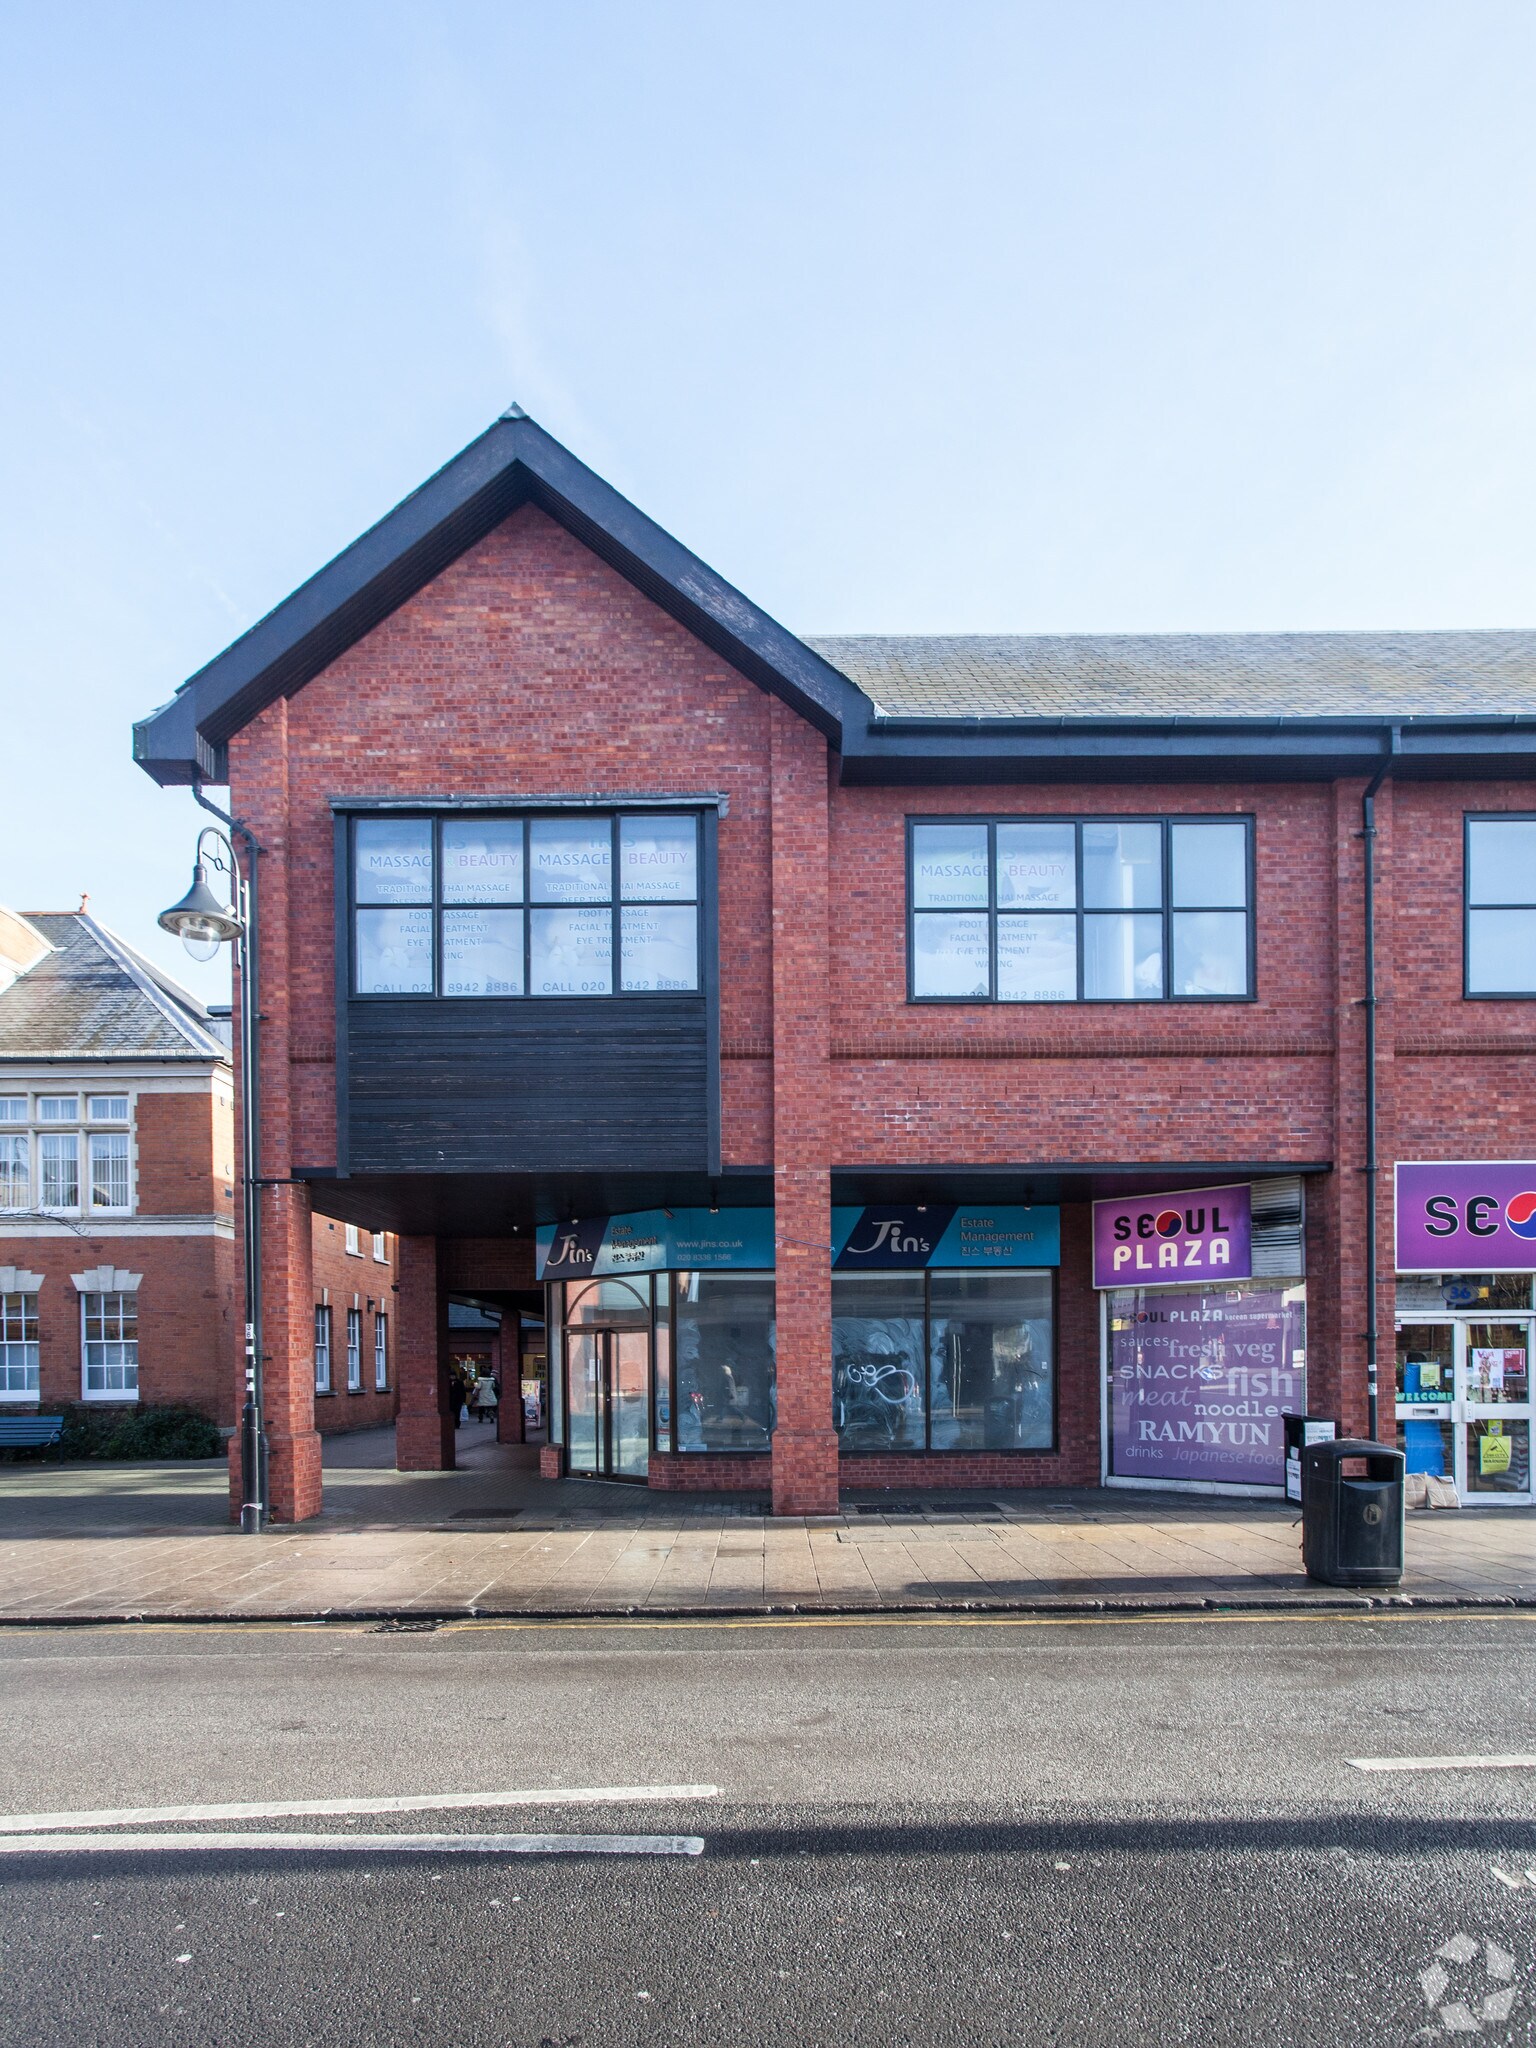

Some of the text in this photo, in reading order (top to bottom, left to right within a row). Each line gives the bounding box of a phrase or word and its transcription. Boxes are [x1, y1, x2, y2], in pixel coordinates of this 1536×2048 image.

[370, 856, 432, 868] MASSAG
[459, 854, 518, 866] BEAUTY
[538, 852, 688, 866] MASSAGE BEAUTY
[921, 865, 989, 876] MASSAGE
[1009, 865, 1066, 876] BEAUTY
[377, 885, 432, 893] TRADITIONA
[467, 884, 510, 892] MASSAGE
[546, 883, 608, 892] TRADITIONAL
[636, 882, 680, 890] MASSAGE
[928, 894, 988, 902] TRADITIONAL
[408, 912, 479, 920] FOOT ASSAGE
[578, 909, 648, 918] FOOT MSSAGE
[400, 924, 488, 934] FACIAL EATMENT
[604, 923, 659, 931] TATMENT
[958, 920, 1028, 928] FOOT SSAGE
[408, 938, 482, 946] EYE TATMENT
[576, 936, 652, 944] EYE TRETMENT
[950, 934, 1038, 942] FACIAL TEATMENT
[595, 950, 634, 958] WANG
[976, 946, 1031, 954] TRTMENT
[974, 960, 1013, 968] WANG
[448, 983, 480, 992] 8942
[486, 982, 518, 992] 8886
[542, 982, 575, 992] CALL
[582, 982, 606, 991] 020
[656, 980, 688, 990] 8886
[1034, 990, 1065, 1000] 8886
[961, 1218, 994, 1228] Estate
[1113, 1207, 1230, 1241] SEOUL
[847, 1220, 930, 1253] Jin's
[960, 1231, 1034, 1243] Management
[546, 1233, 594, 1266] Jin's
[676, 1240, 743, 1249] www.jins.co.uk
[1113, 1238, 1230, 1271] PLAZA
[1450, 1286, 1471, 1300] 36
[1170, 1310, 1223, 1322] PLAZA
[1120, 1336, 1276, 1364] sauces fresh veg
[1120, 1364, 1224, 1380] SNACKS
[1226, 1365, 1293, 1396] fish
[1121, 1385, 1196, 1407] meat
[1395, 1392, 1453, 1401] WELCOME
[1194, 1401, 1294, 1417] noodles
[1138, 1420, 1272, 1446] RAMYUN
[1126, 1446, 1164, 1459] drinks
[1172, 1447, 1244, 1464] Japanese
